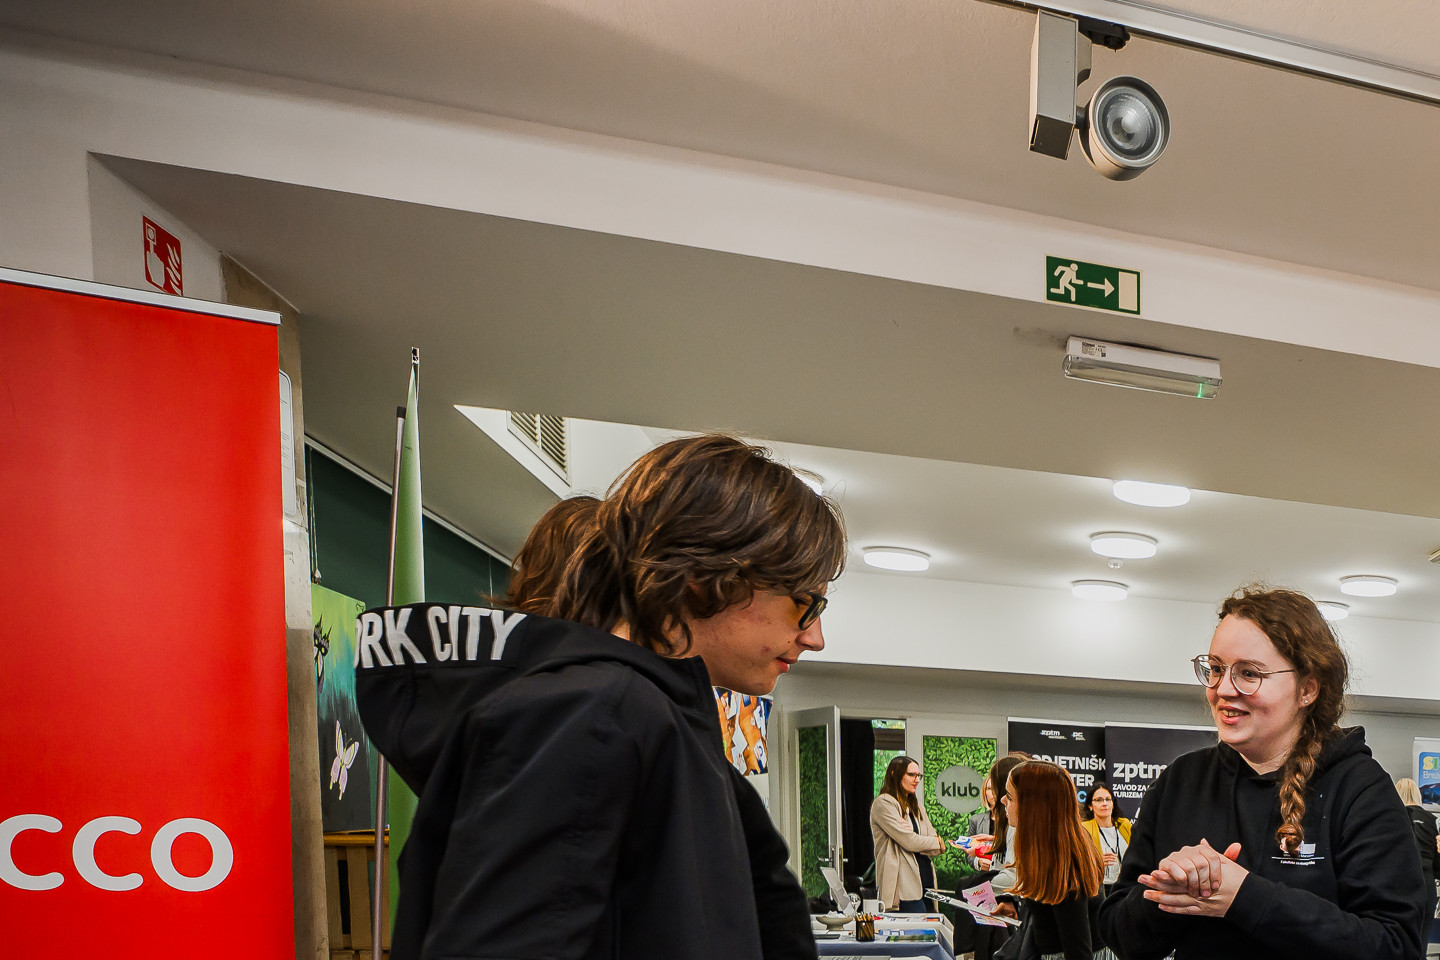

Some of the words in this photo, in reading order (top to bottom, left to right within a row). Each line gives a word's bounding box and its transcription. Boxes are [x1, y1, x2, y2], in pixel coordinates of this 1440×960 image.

[353, 608, 427, 668] RK
[427, 605, 528, 662] CITY
[941, 781, 980, 798] klub
[1112, 783, 1137, 792] ZAVOD
[1113, 791, 1143, 799] TURIZEM
